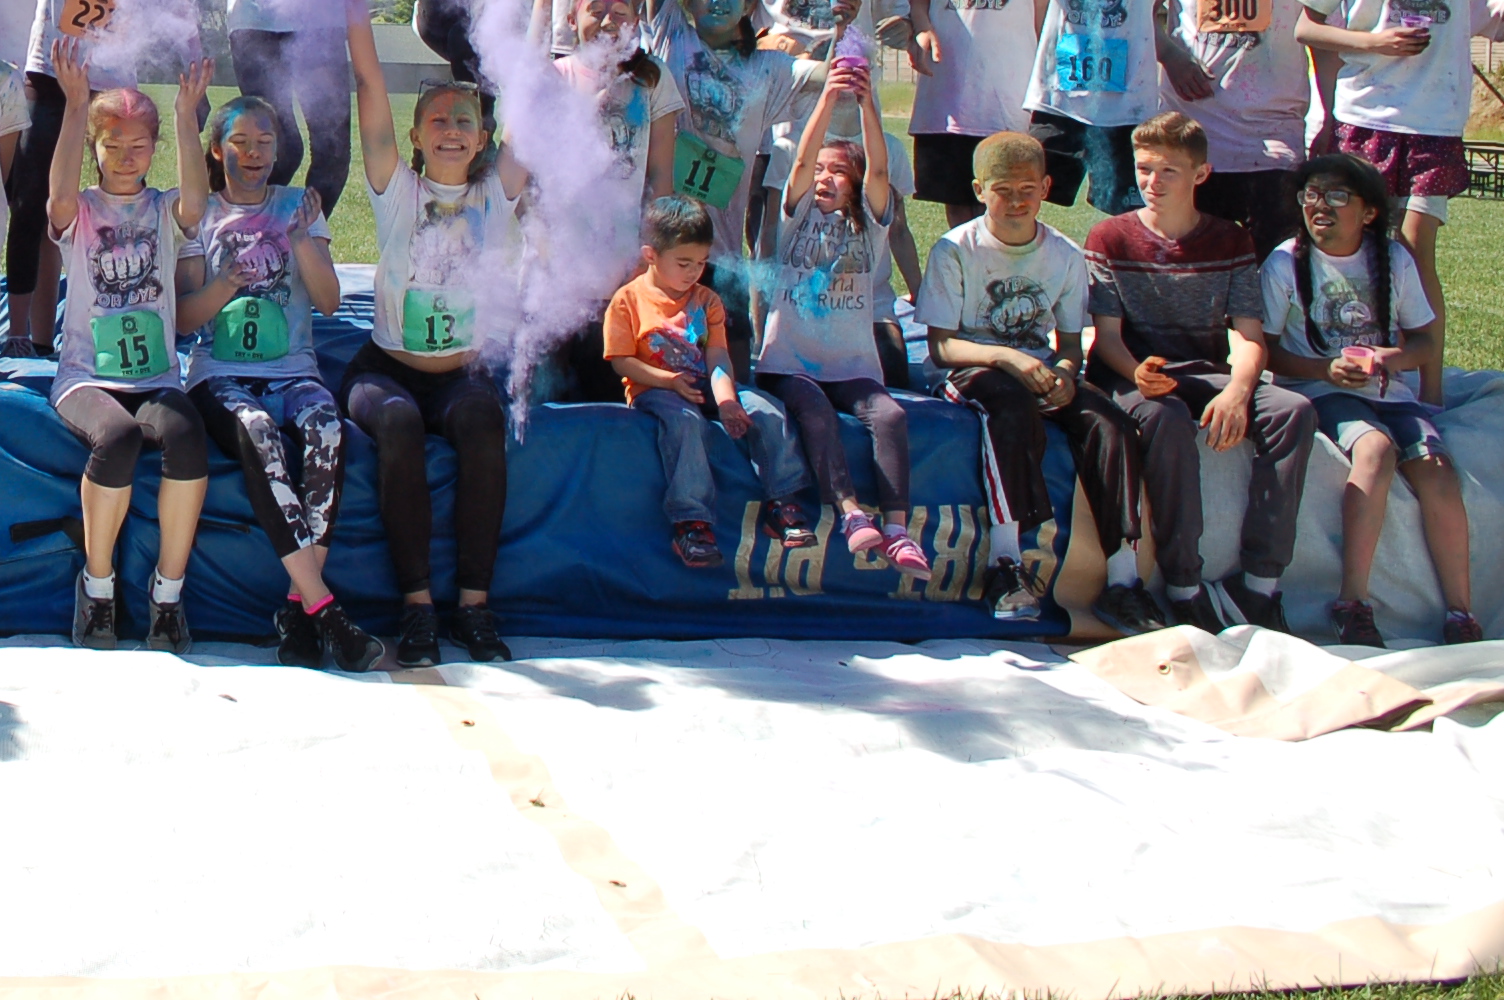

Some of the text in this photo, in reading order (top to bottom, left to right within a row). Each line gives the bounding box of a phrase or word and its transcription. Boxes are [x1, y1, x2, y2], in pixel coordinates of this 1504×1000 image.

[72, 0, 114, 30] 22
[1068, 55, 1113, 81] 160
[685, 160, 716, 192] 11
[97, 286, 158, 308] OR DYE
[242, 321, 258, 350] 8
[425, 314, 456, 345] 13
[117, 335, 150, 369] 15
